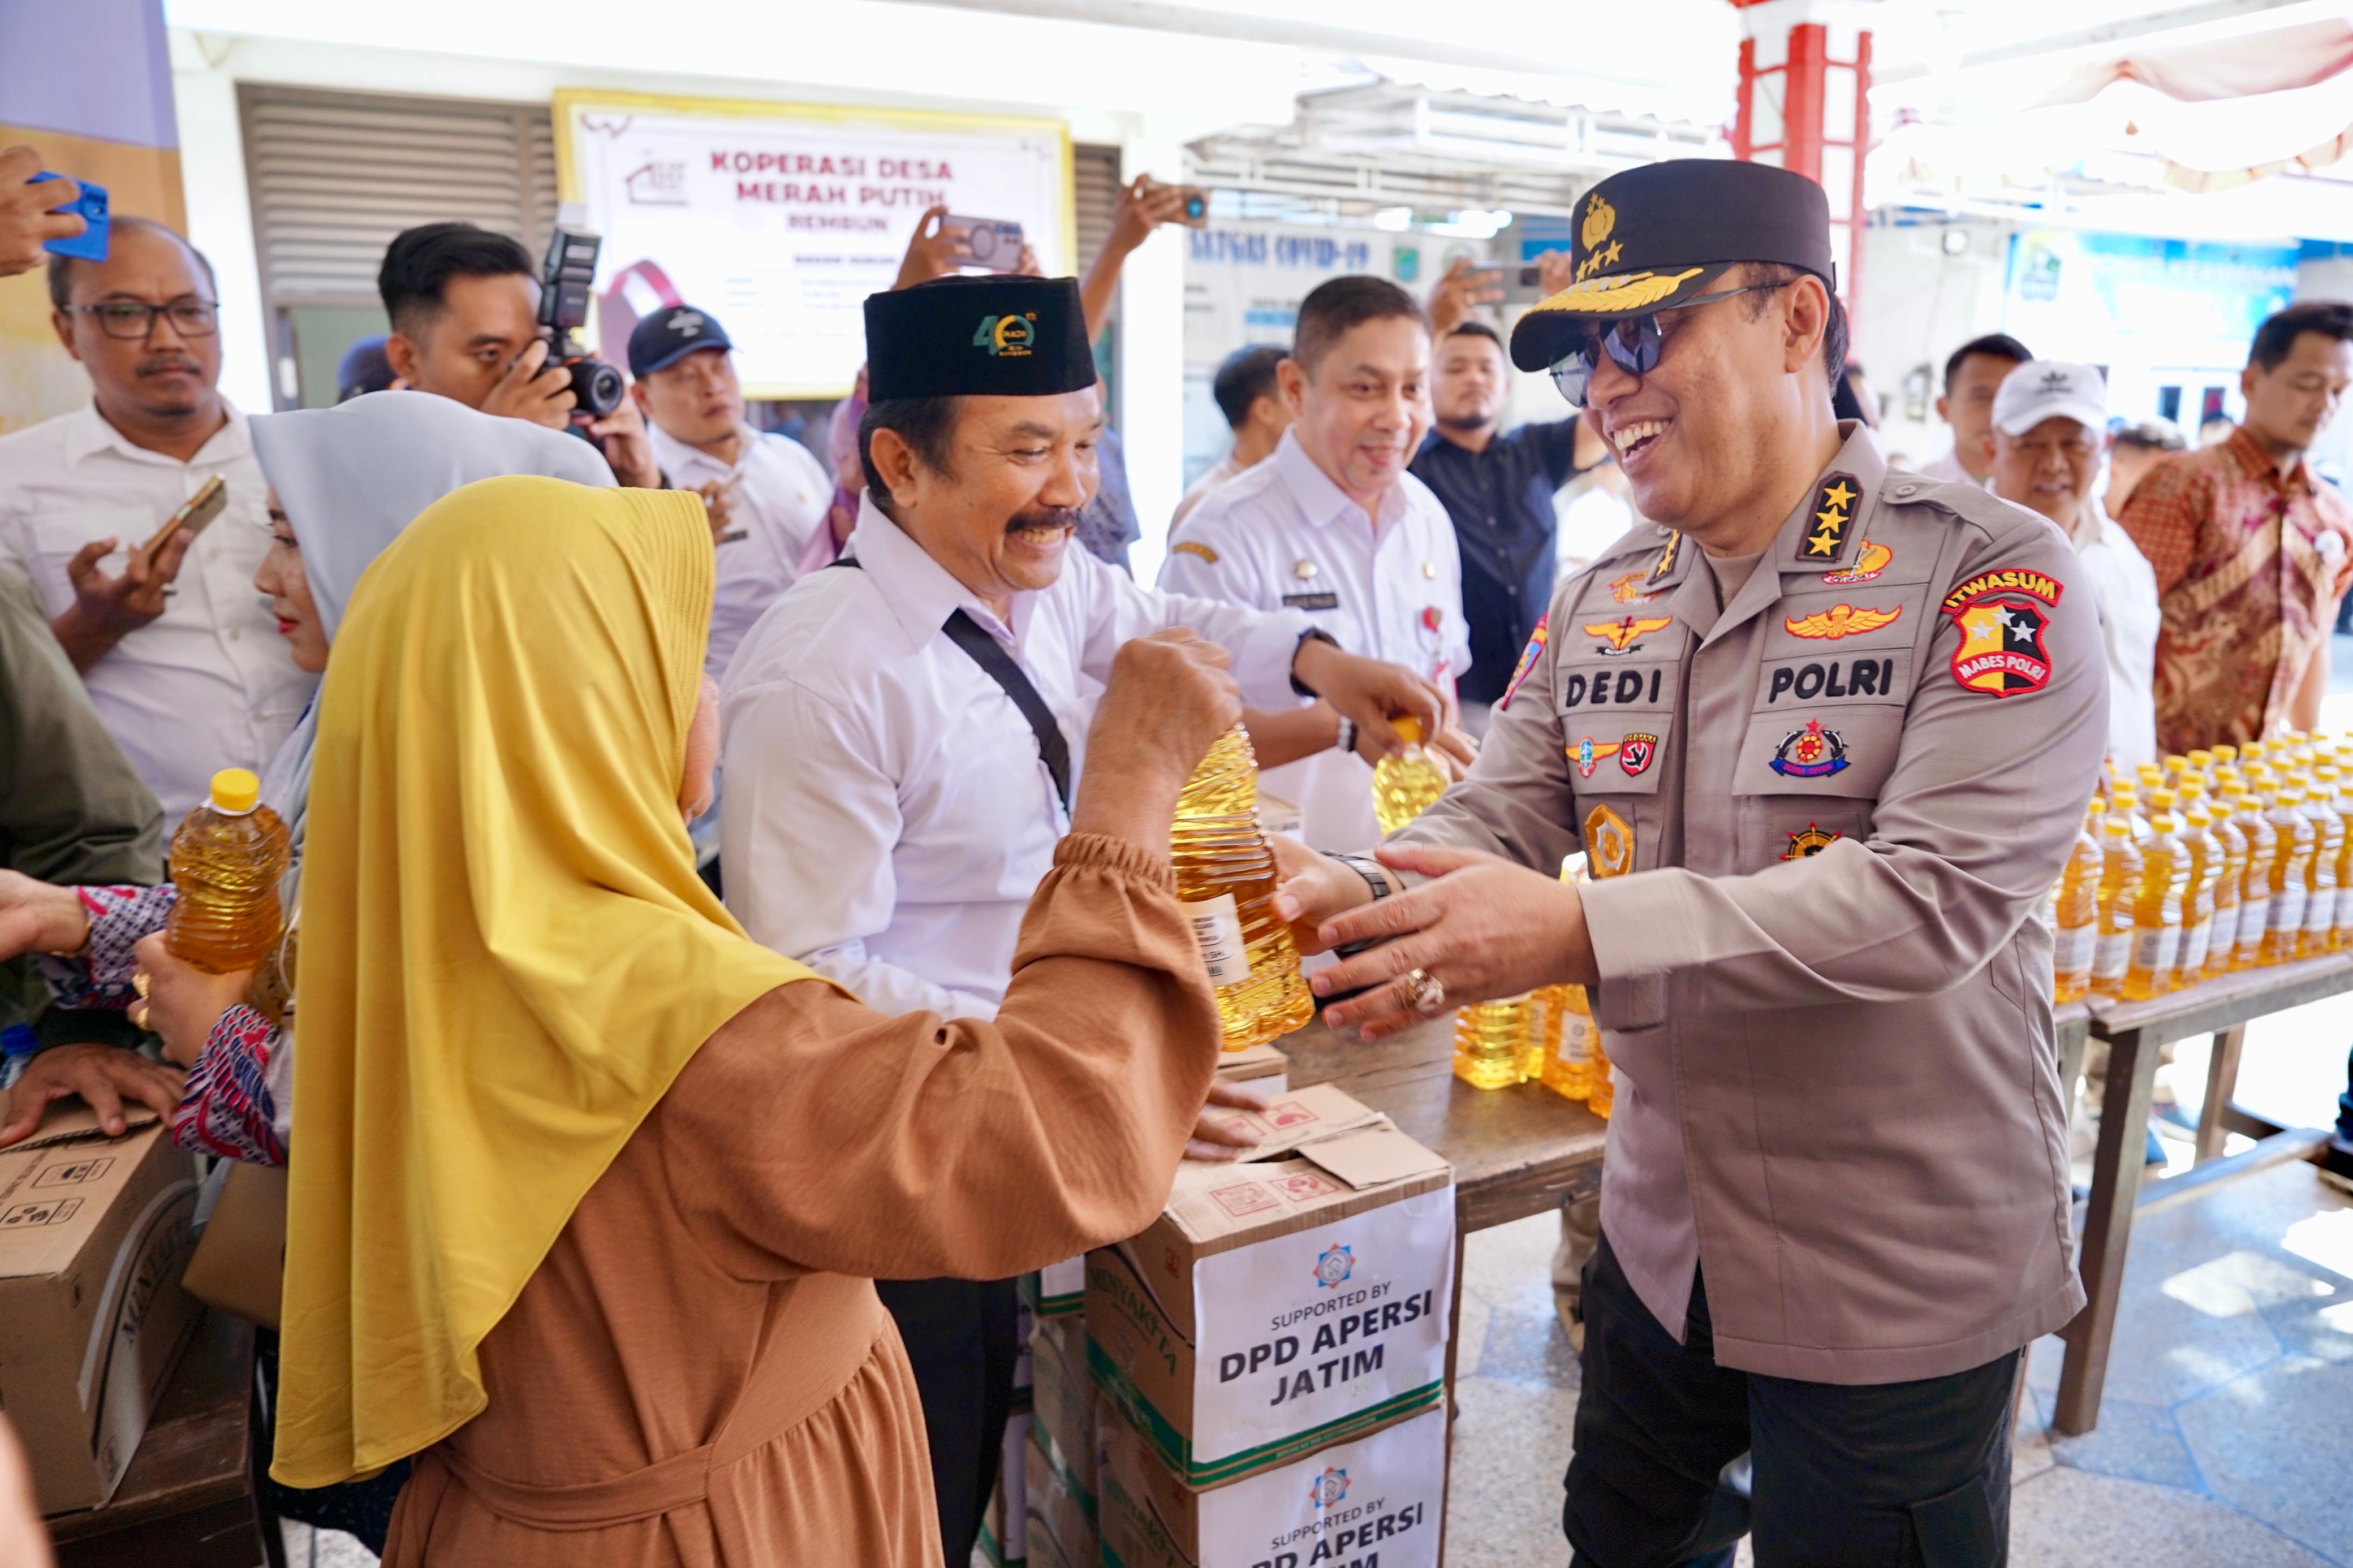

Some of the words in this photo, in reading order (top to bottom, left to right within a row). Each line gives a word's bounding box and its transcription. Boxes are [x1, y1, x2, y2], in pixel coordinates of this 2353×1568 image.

[712, 152, 865, 176] KOPERASI
[879, 159, 953, 180] DESA
[737, 182, 846, 204] MERAH
[860, 187, 945, 207] PUTIH
[1275, 234, 1369, 269] COVID-19
[1945, 571, 2055, 608] ITWASUM
[1565, 668, 1662, 708] DEDI
[1768, 658, 1894, 703] POLRI
[1958, 655, 2005, 679] MABES
[2006, 655, 2046, 680] POLRI
[1270, 1289, 1367, 1332] SUPPORTED
[1371, 1280, 1392, 1300] BY
[1219, 1335, 1299, 1384] DPD
[1311, 1289, 1433, 1355] APERSI
[1270, 1342, 1385, 1406] JATIM
[1270, 1506, 1362, 1550] SUPPORTED
[1365, 1496, 1386, 1515] BY
[1309, 1501, 1424, 1566] APERSI
